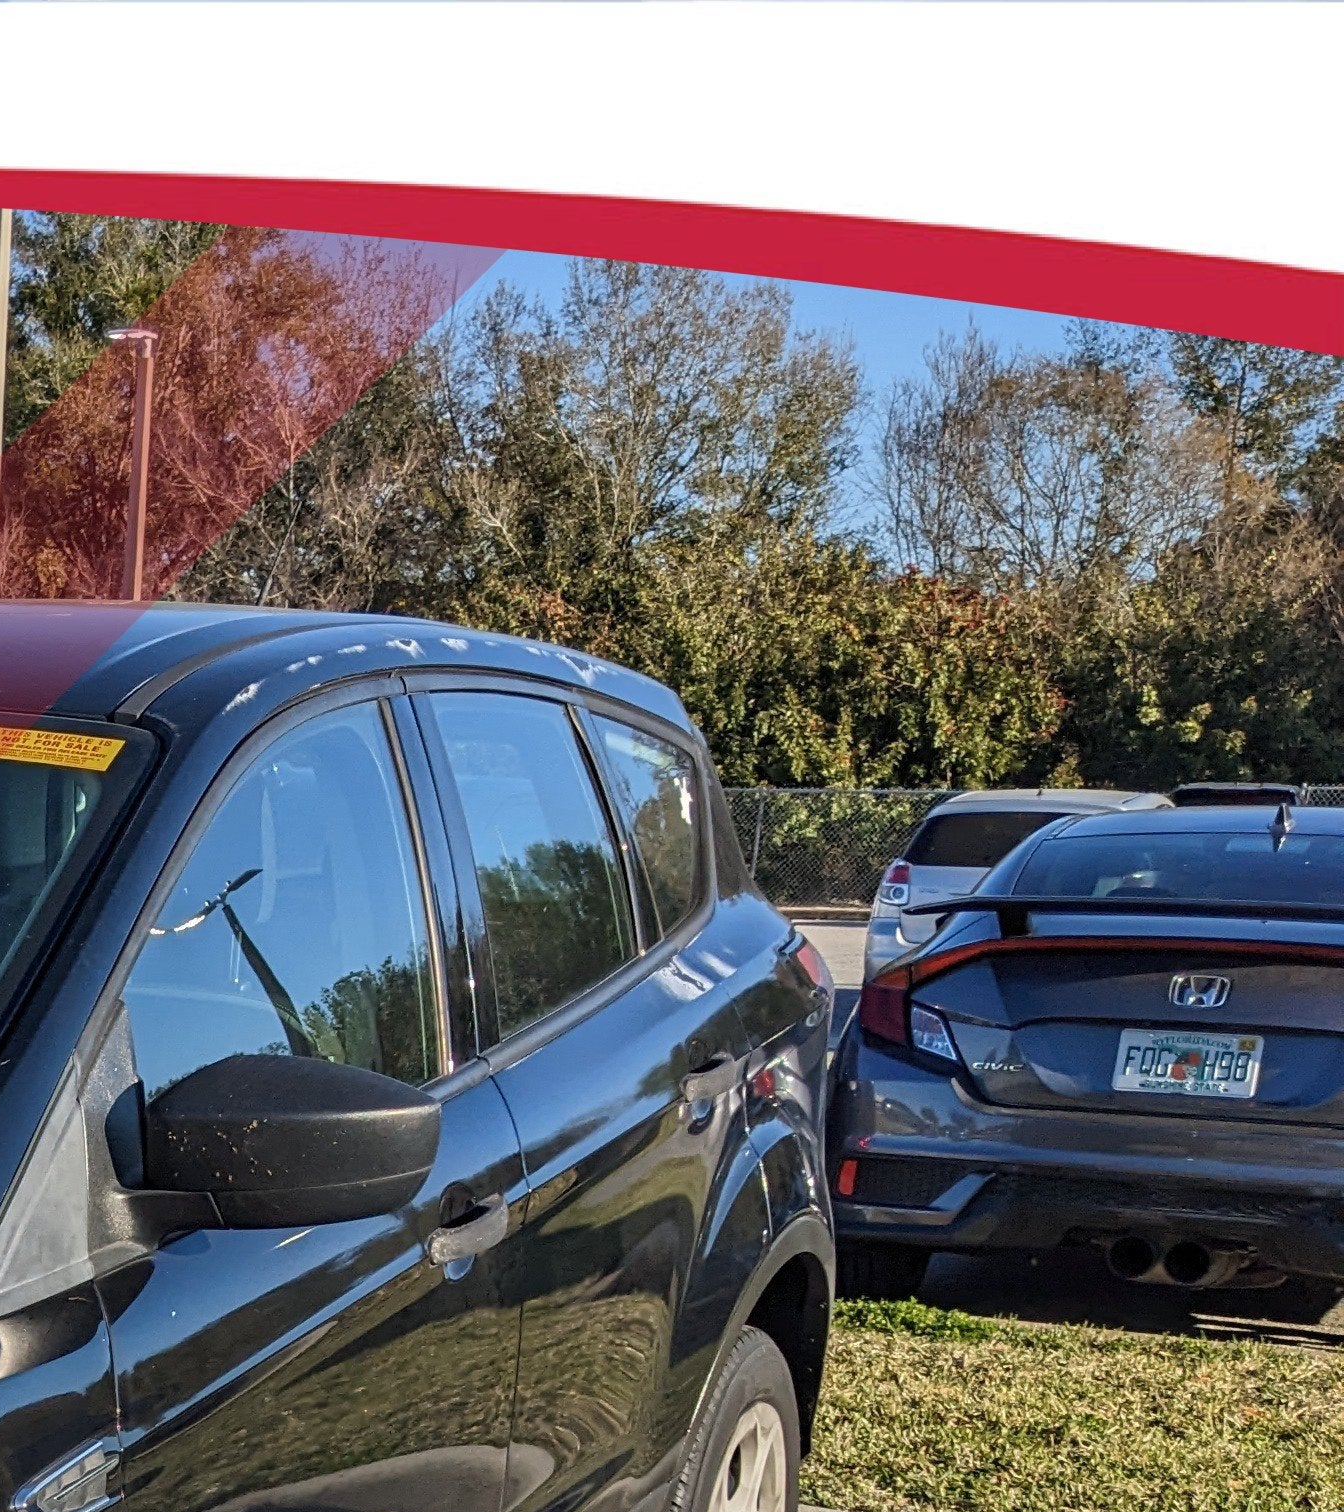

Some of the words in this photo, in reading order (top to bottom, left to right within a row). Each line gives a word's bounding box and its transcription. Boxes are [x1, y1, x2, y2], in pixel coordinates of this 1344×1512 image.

[0, 729, 30, 739] THIS
[36, 731, 94, 745] VEHICLE
[98, 739, 113, 748] IS
[0, 736, 28, 746] NOT
[34, 739, 60, 748] FOR
[64, 741, 102, 753] SALE
[1202, 1050, 1252, 1082] H98
